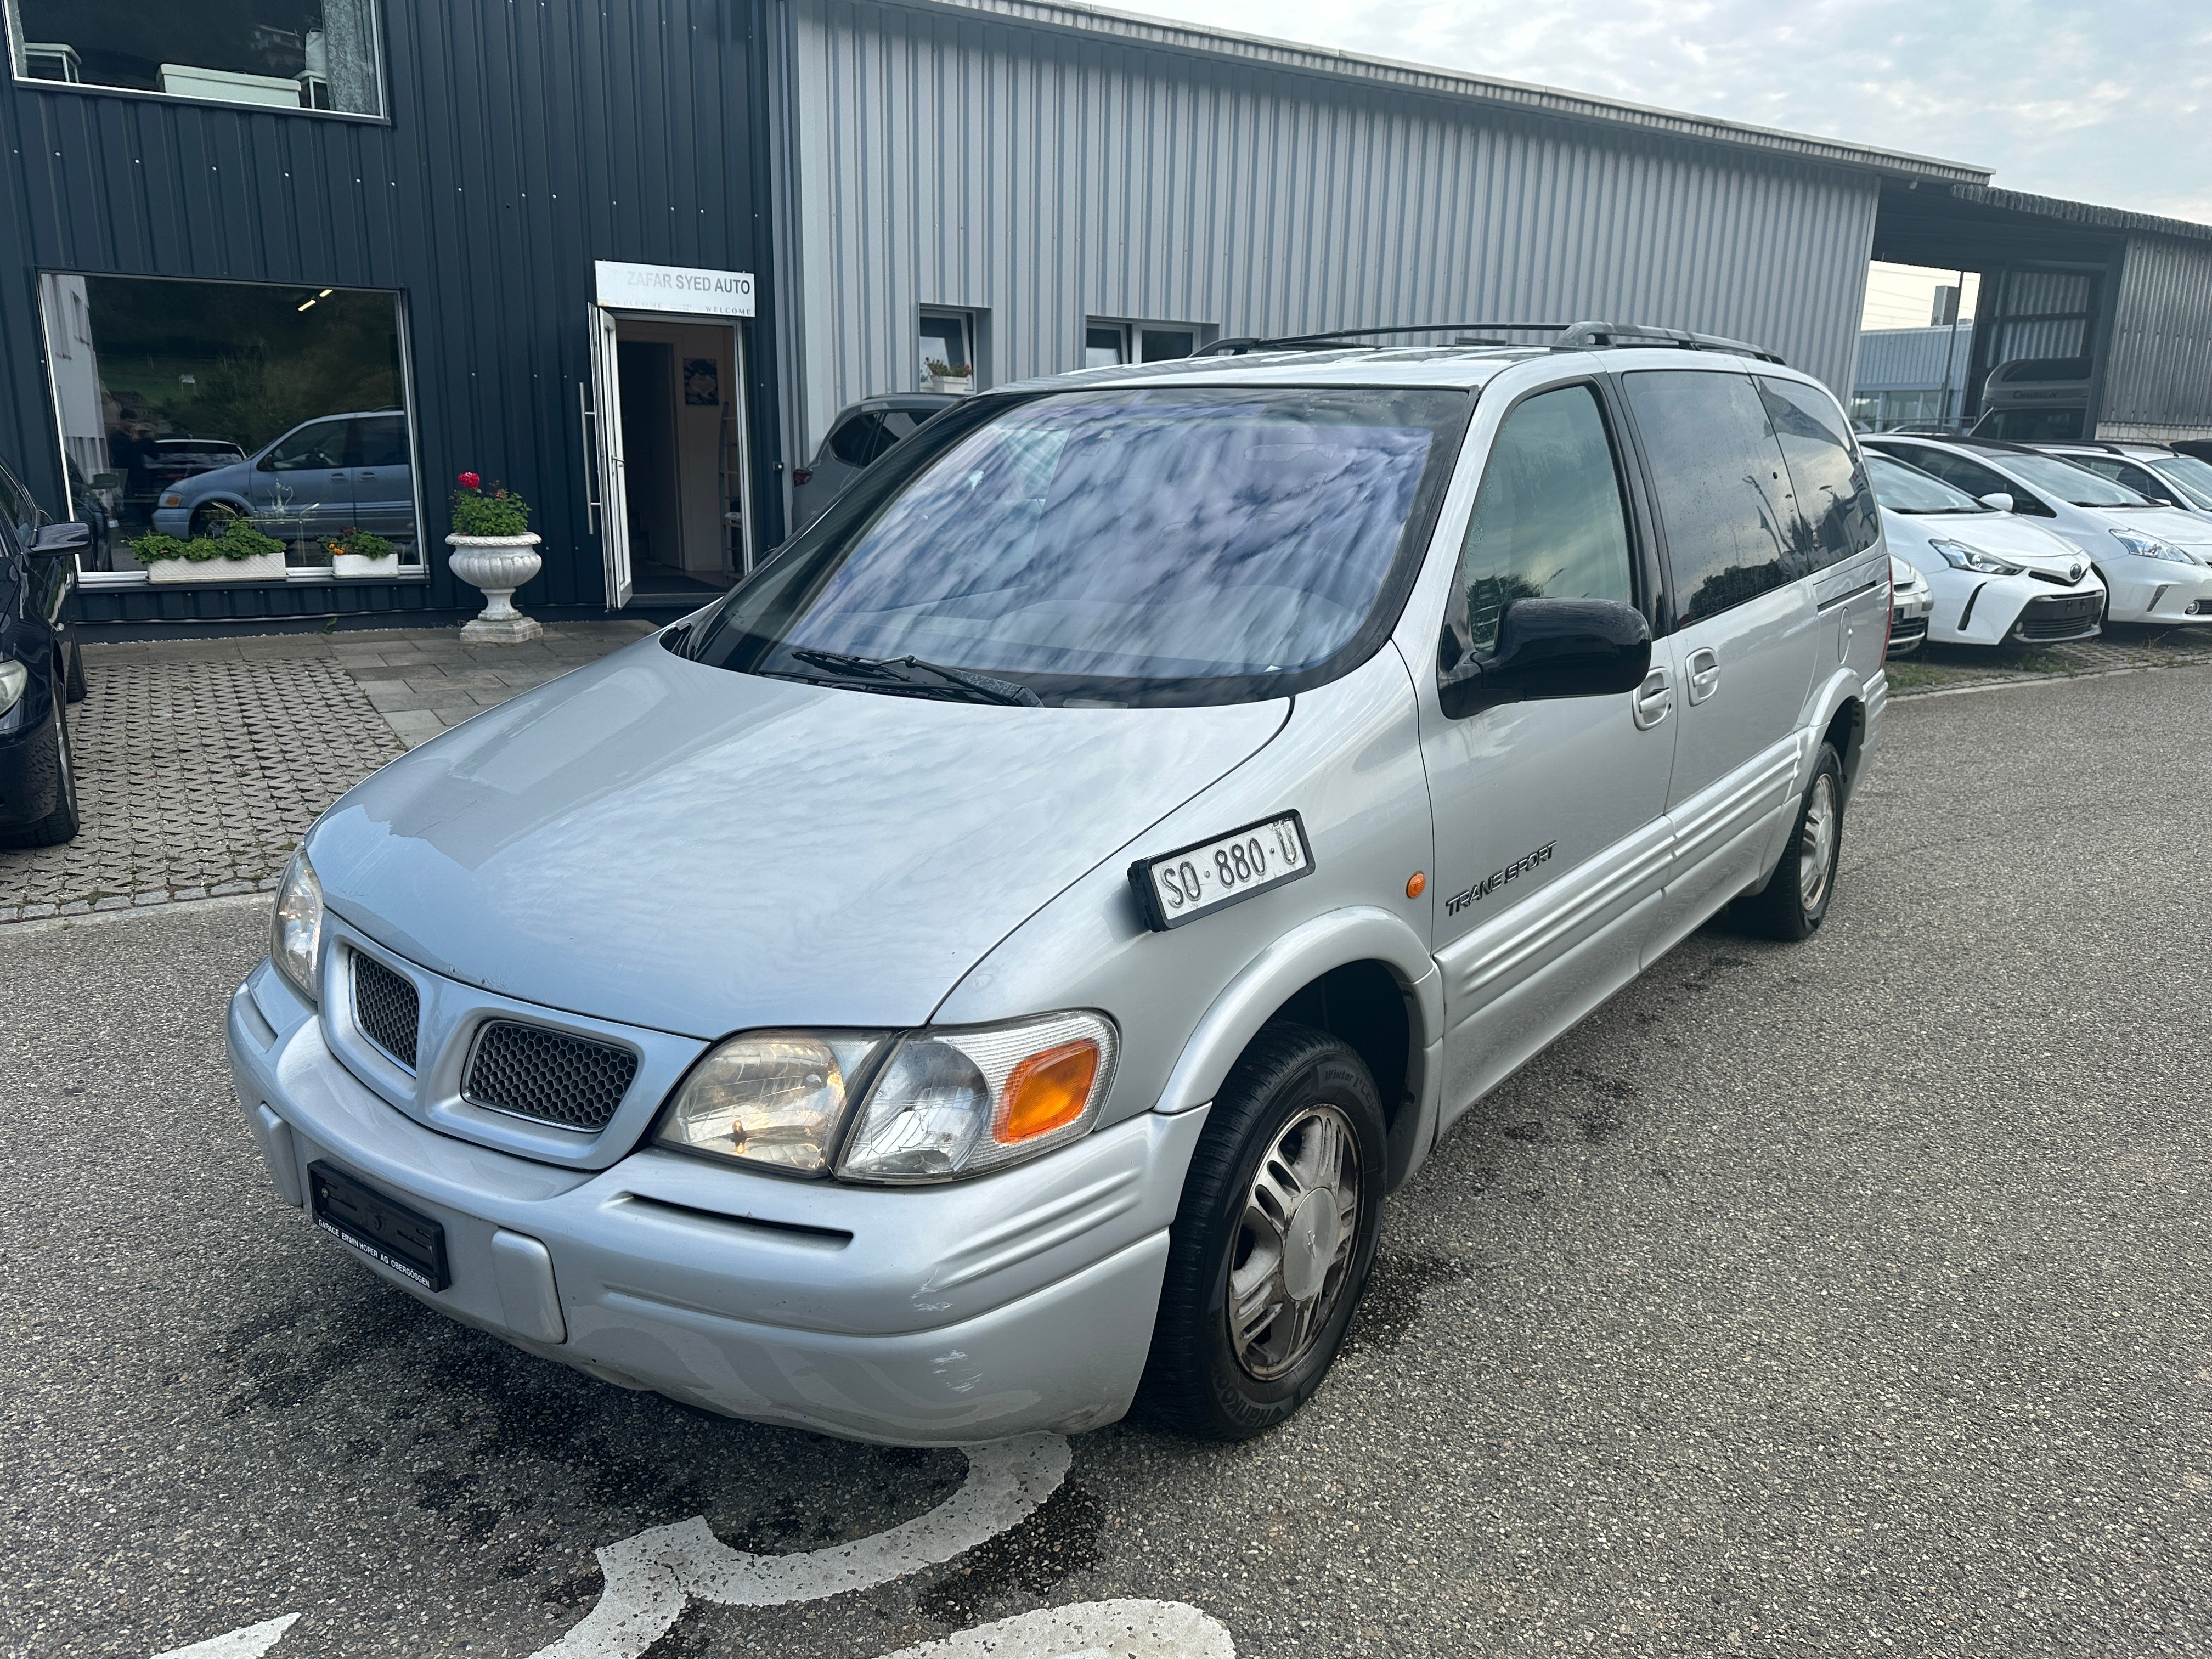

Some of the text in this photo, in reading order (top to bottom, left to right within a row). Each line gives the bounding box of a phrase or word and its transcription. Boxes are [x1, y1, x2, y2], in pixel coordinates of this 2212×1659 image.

[627, 270, 751, 295] ZAFAR SYED AUTO
[614, 299, 662, 309] WELCOME
[706, 306, 752, 315] WELCOME
[1446, 839, 1558, 916] TRANS SPORT
[318, 1219, 430, 1288] GARAGE ERWIN HOFER AG OBERGÖSGEN
